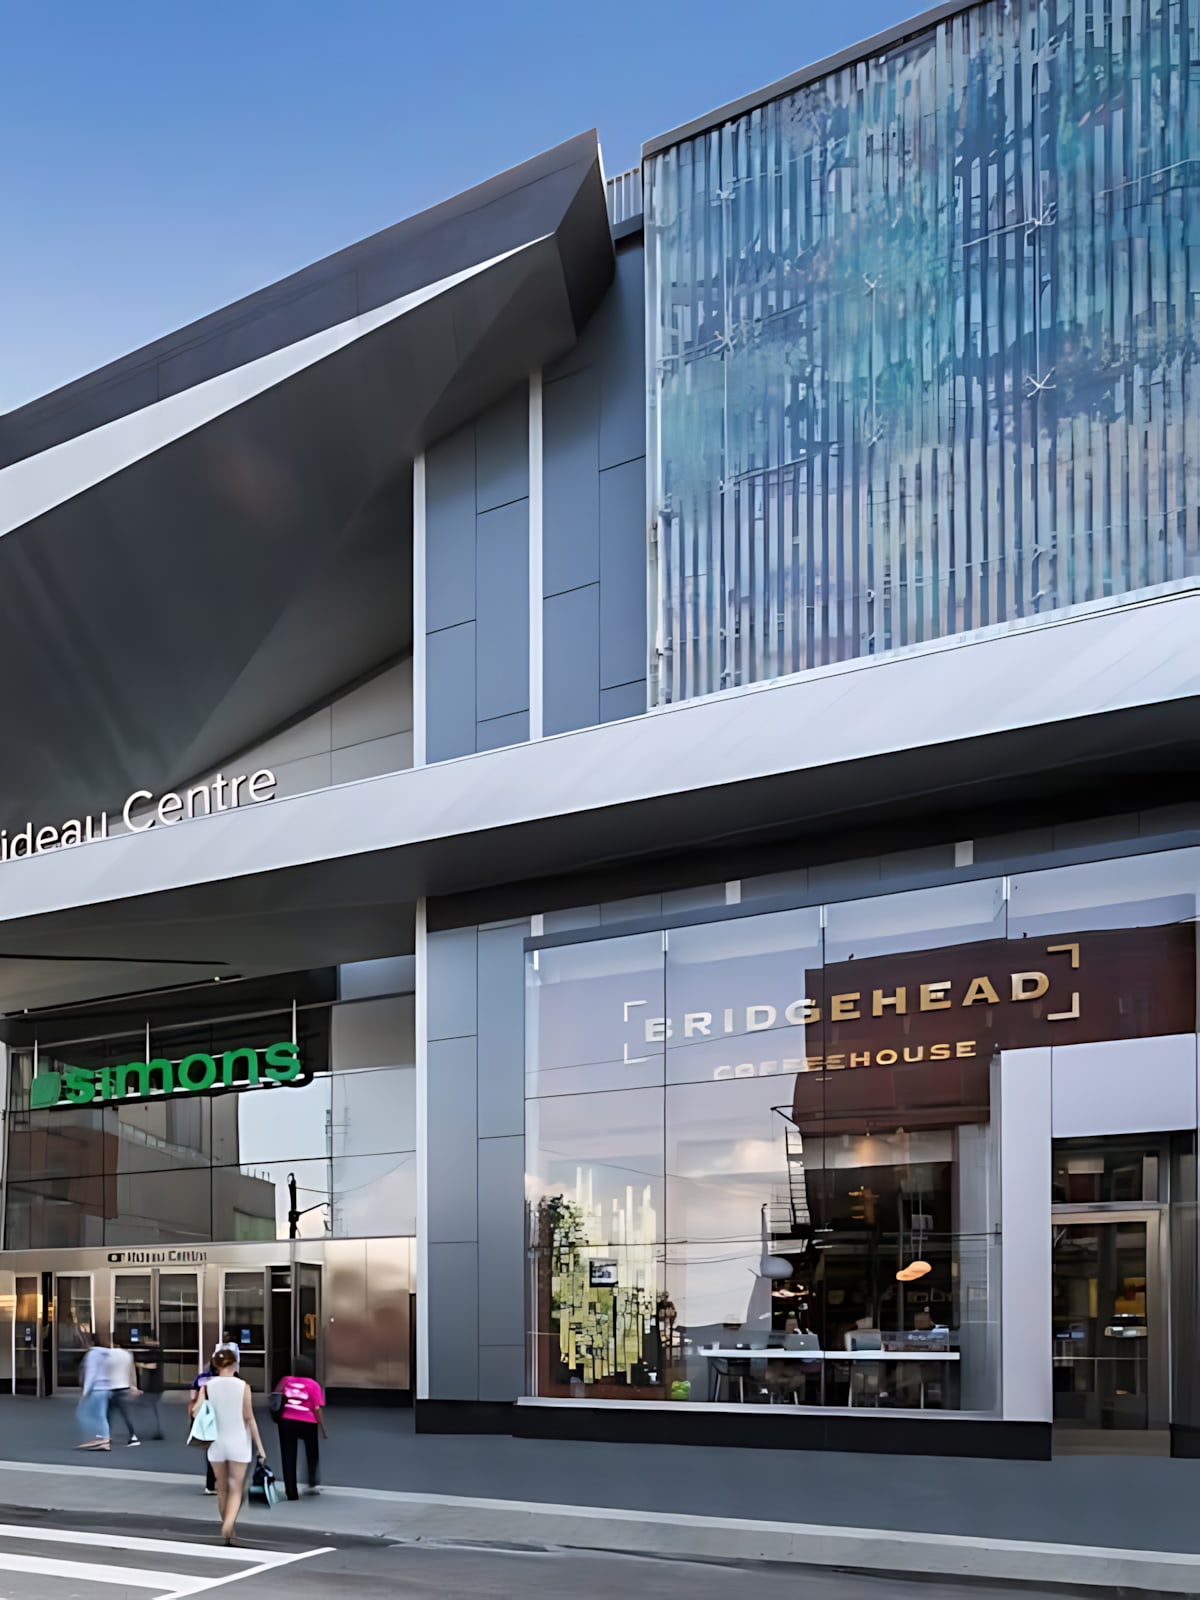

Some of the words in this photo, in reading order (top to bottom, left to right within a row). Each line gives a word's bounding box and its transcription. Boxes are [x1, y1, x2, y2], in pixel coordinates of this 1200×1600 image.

[123, 768, 277, 833] Centre
[645, 971, 1050, 1042] BRIDGEHEAD
[65, 1042, 300, 1104] simons
